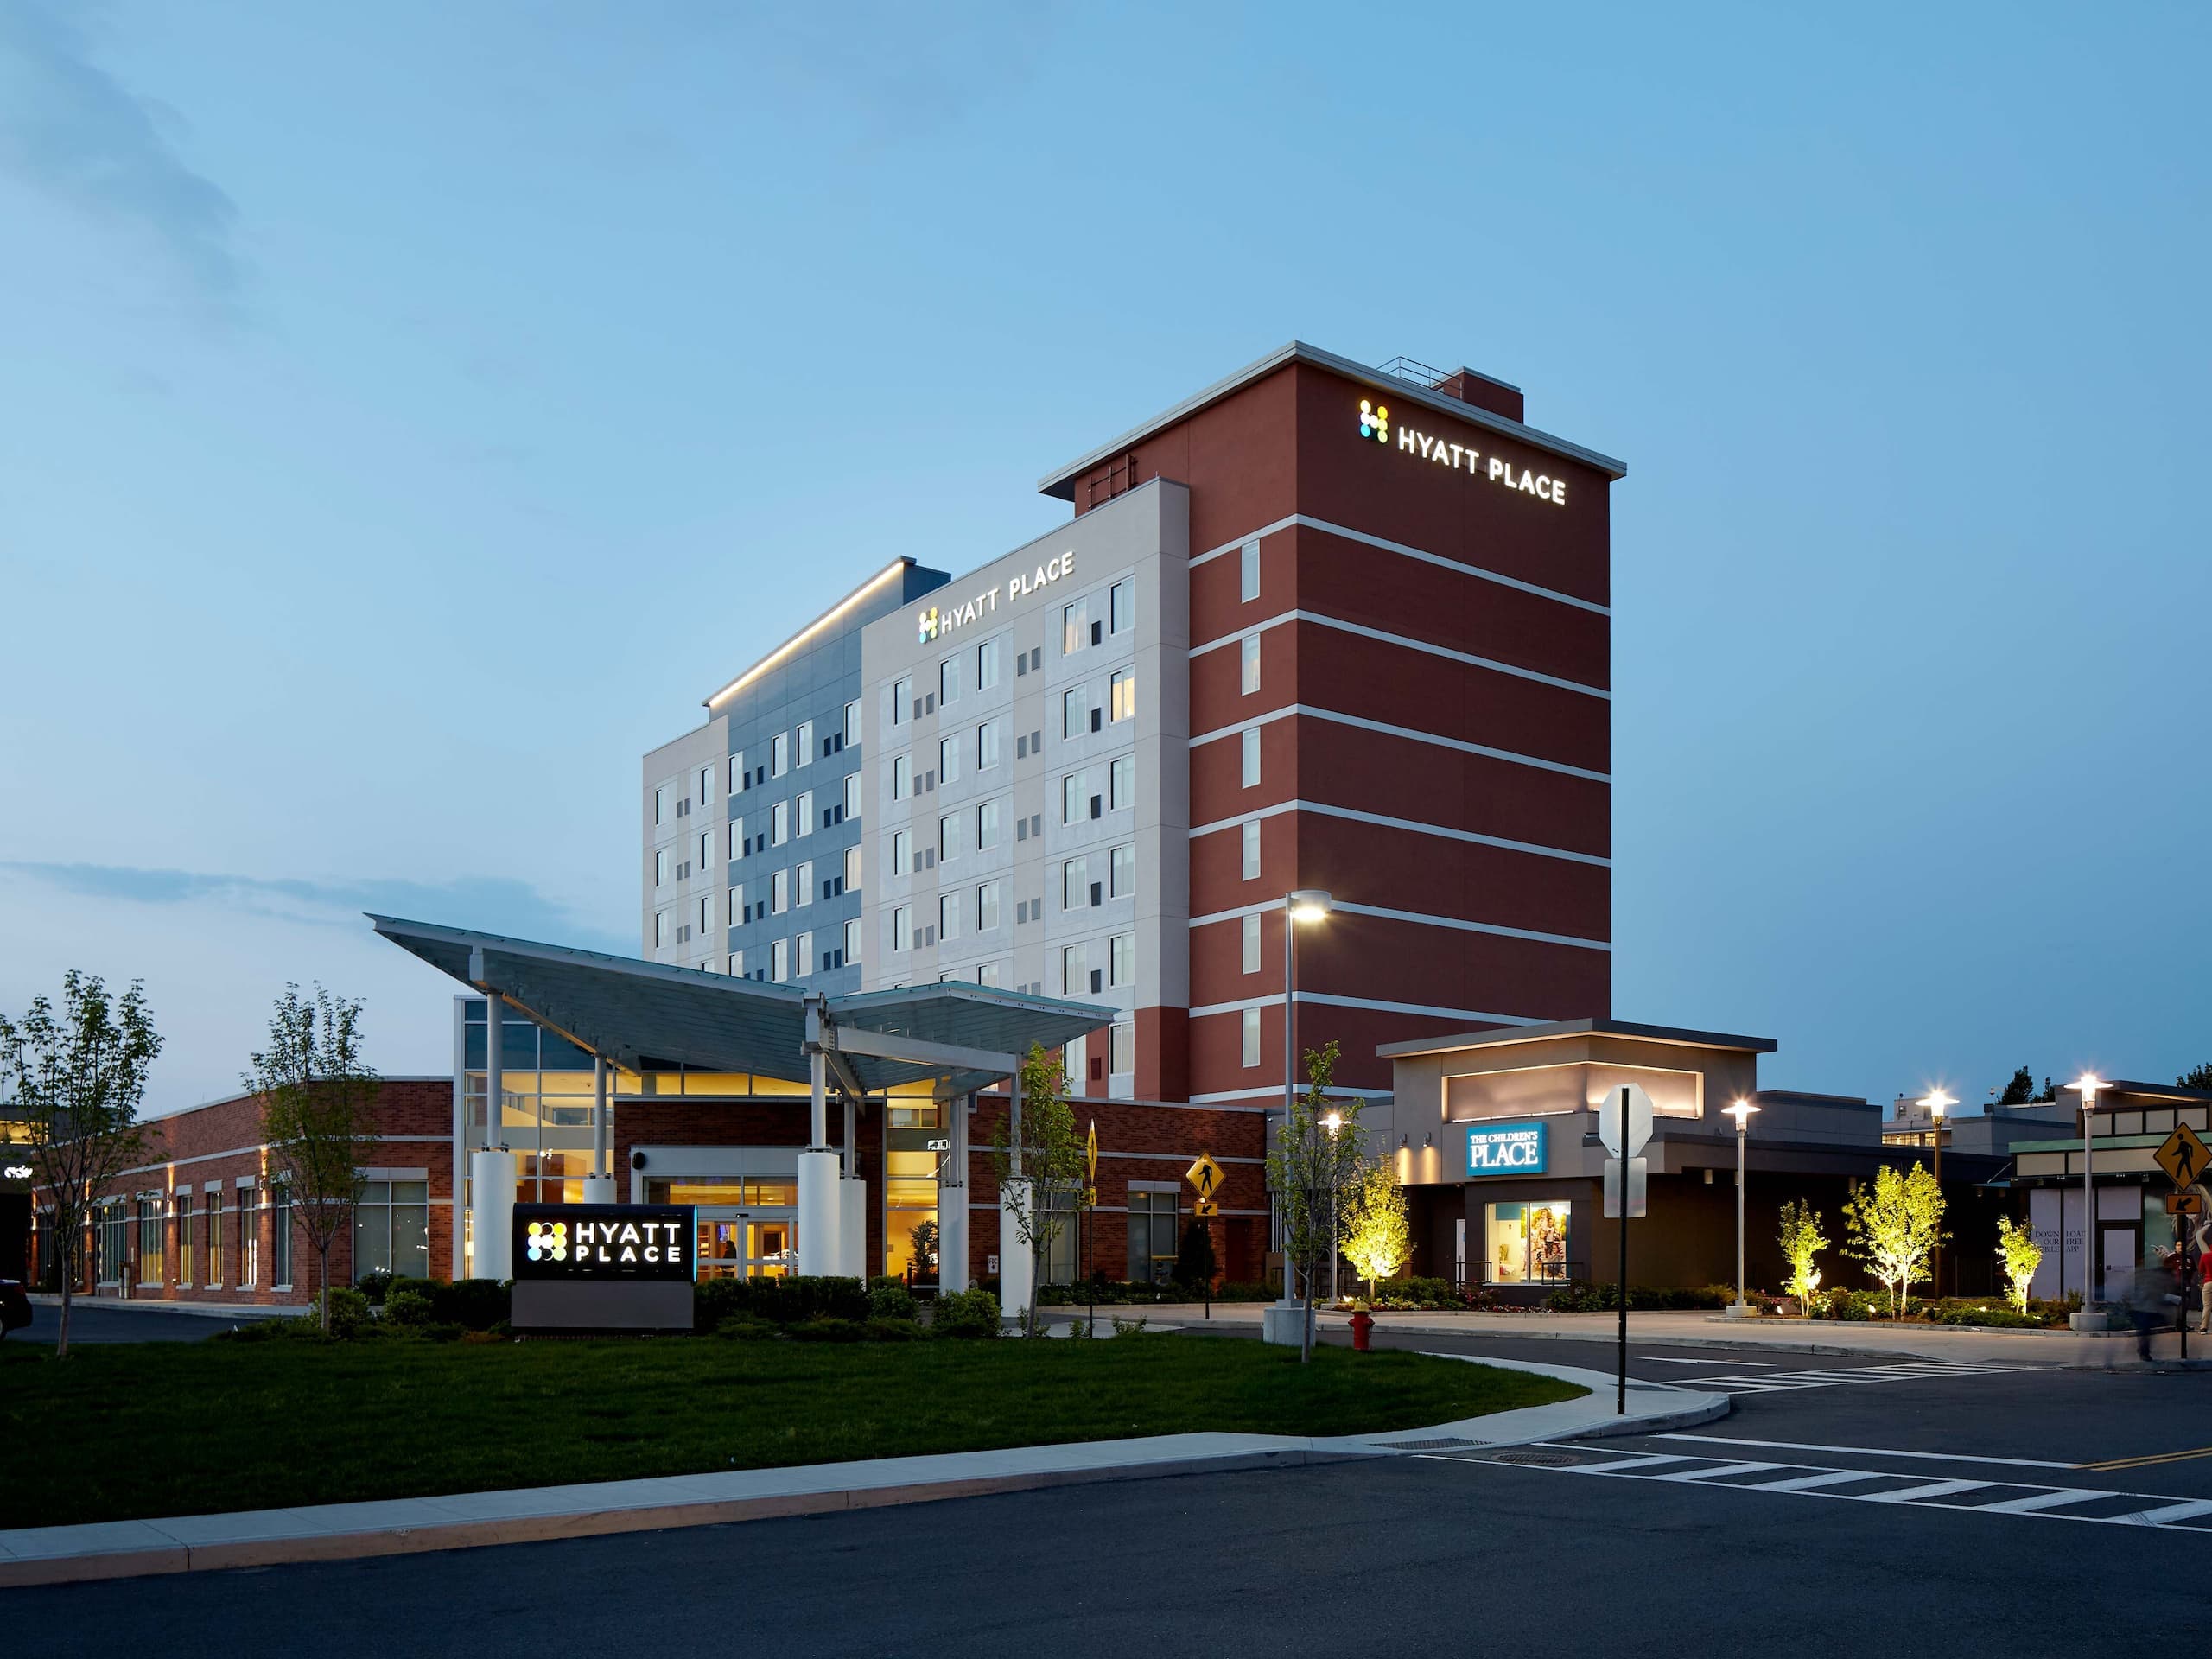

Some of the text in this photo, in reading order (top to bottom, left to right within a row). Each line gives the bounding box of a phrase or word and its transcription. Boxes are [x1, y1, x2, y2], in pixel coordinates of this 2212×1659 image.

[1398, 426, 1566, 505] HYATT PLACE
[941, 551, 1073, 634] HYATT PLACE
[1470, 1131, 1538, 1144] THE CHILDREN'S
[1470, 1141, 1538, 1168] PLACE
[575, 1222, 681, 1244] HYATT
[575, 1246, 681, 1262] PLACE
